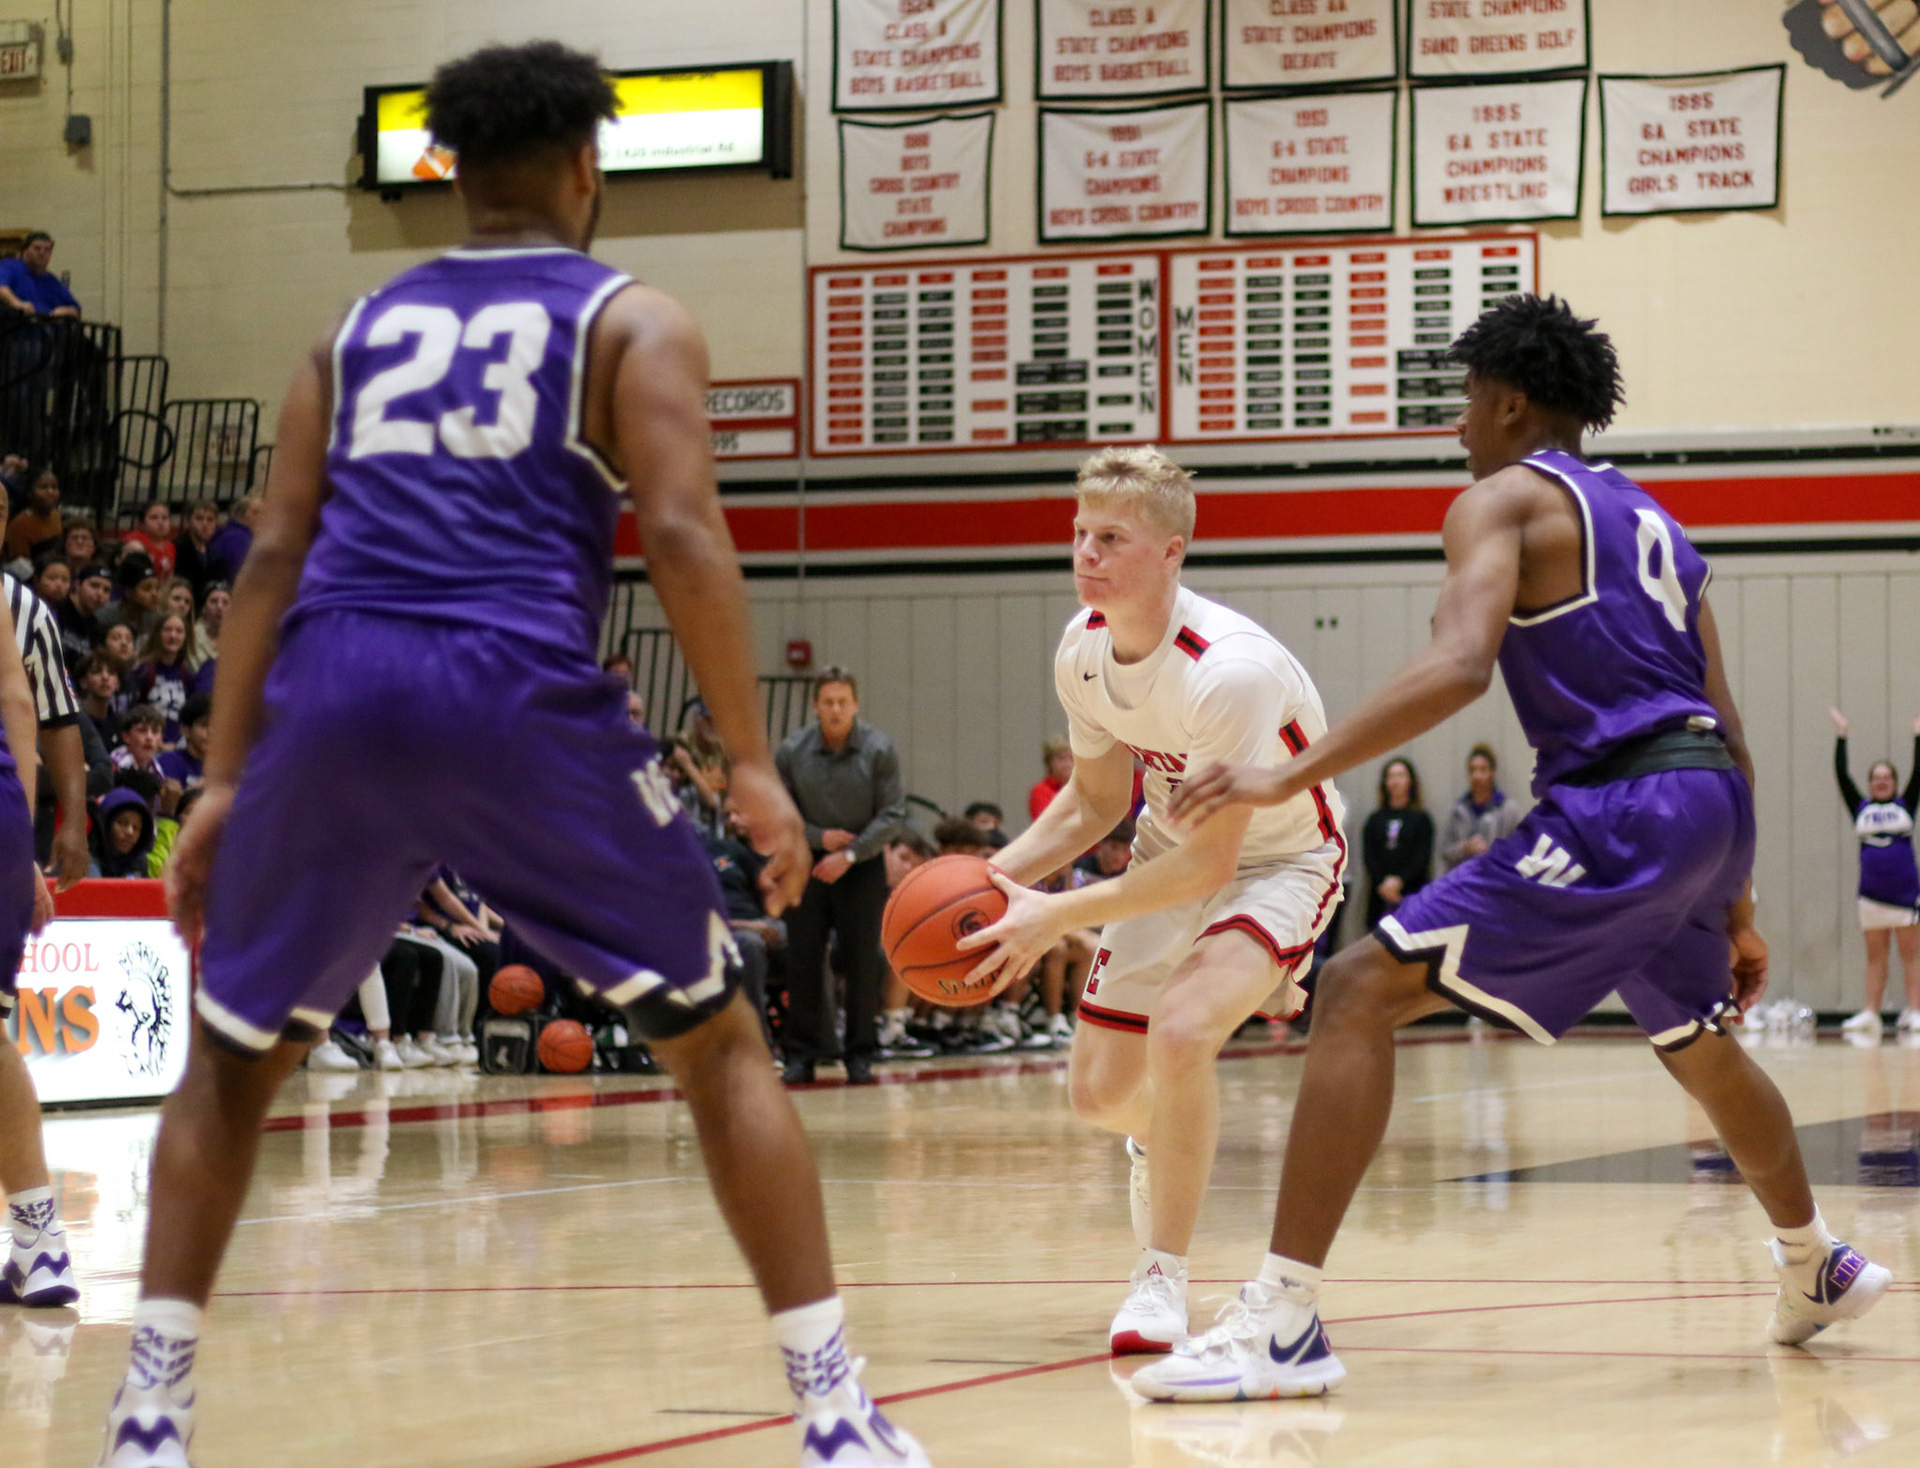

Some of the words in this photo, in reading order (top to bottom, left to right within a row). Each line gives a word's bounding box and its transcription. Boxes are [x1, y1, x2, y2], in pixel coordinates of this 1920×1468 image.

[1088, 7, 1137, 27] CLASS
[1145, 5, 1156, 24] A
[1429, 0, 1471, 18] STATE
[884, 23, 929, 40] CLASS
[1056, 36, 1098, 55] STATE
[1107, 29, 1191, 53] CHAMPIONS
[1242, 25, 1284, 44] STATE
[1294, 19, 1378, 43] CHAMPIONS
[1420, 36, 1460, 55] SAND
[1469, 32, 1528, 53] GREENS
[1537, 29, 1576, 49] GOLF
[852, 49, 893, 67] STATE
[900, 42, 981, 67] CHAMPIONS
[1280, 52, 1338, 71] DEBATE
[1054, 63, 1092, 82] BOYS
[1099, 58, 1192, 81] BASKETBALL
[850, 76, 885, 94] BOYS
[894, 70, 985, 93] BASKETBALL
[1447, 132, 1472, 152] 6A
[1488, 128, 1548, 149] STATE
[1641, 122, 1665, 141] 6A
[1687, 117, 1741, 137] STATE
[1119, 148, 1160, 167] STATE
[1306, 136, 1348, 156] STATE
[1637, 143, 1745, 167] CHAMPIONS
[1270, 165, 1350, 185] CHAMPIONS
[1446, 155, 1548, 177] CHAMPIONS
[869, 177, 905, 194] CROSS
[910, 172, 960, 193] COUNTRY
[1084, 175, 1161, 196] CHAMPIONS
[1443, 181, 1548, 204] WRESTLING
[1627, 174, 1679, 195] GIRLS
[1696, 170, 1754, 189] TRACK
[896, 197, 932, 215] STATE
[1050, 208, 1084, 226] BOYS
[1091, 205, 1132, 225] CROSS
[1138, 202, 1199, 222] COUNTRY
[1236, 198, 1269, 216] BOYS
[1276, 196, 1318, 216] CROSS
[1325, 193, 1384, 213] COUNTRY
[883, 218, 947, 238] CHAMPIONS
[1139, 279, 1156, 413] WOMEN
[1175, 306, 1193, 386] MEN
[348, 302, 551, 459] 23
